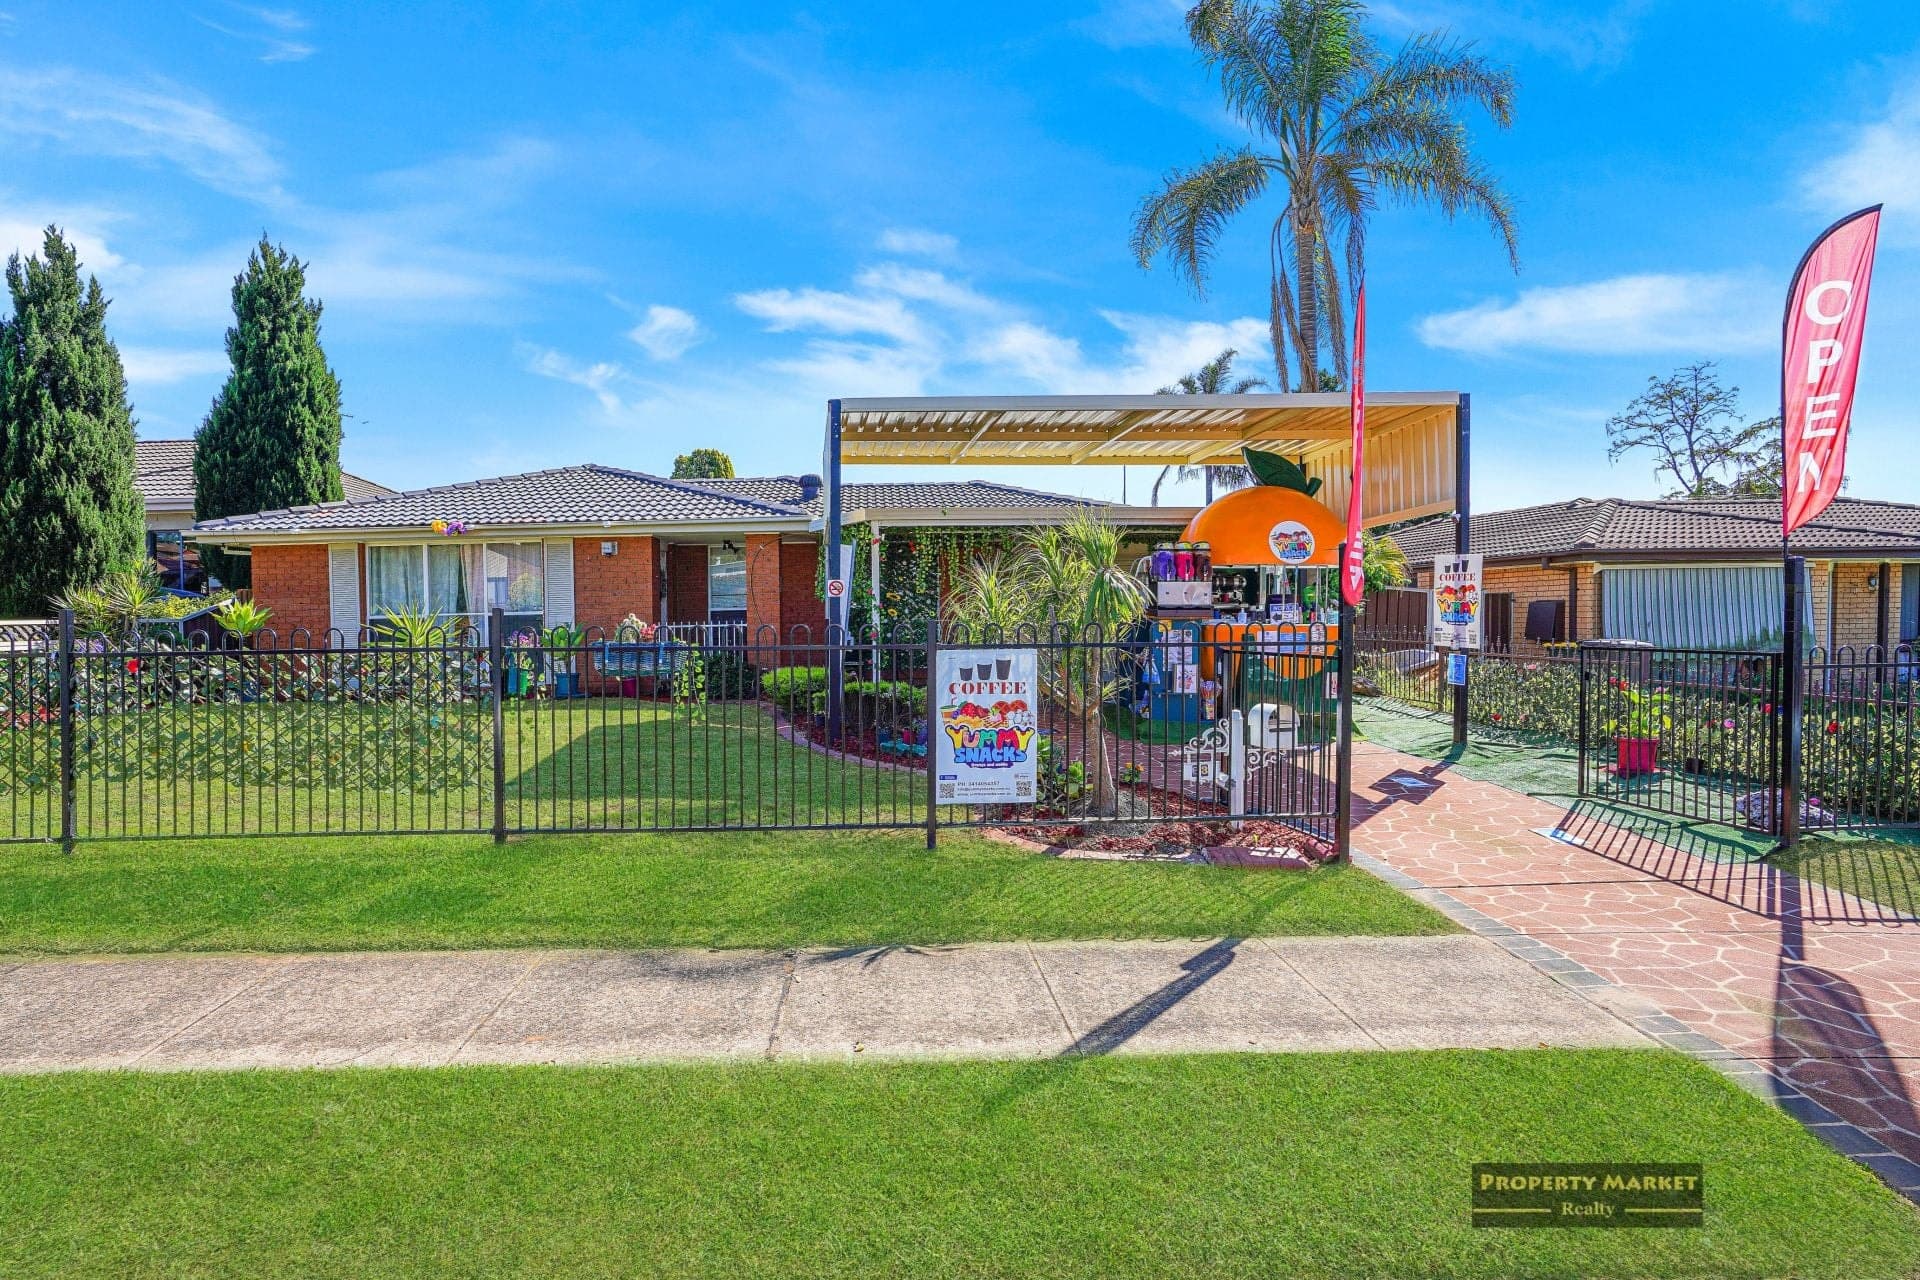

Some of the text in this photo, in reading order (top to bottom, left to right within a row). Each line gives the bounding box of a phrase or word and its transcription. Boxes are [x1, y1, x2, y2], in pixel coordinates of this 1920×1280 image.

[1798, 279, 1852, 494] OPEN
[1439, 573, 1476, 581] COFFEE
[948, 682, 1026, 695] COFFEE
[945, 725, 1035, 751] YUMMY
[954, 746, 1028, 763] SNACKS
